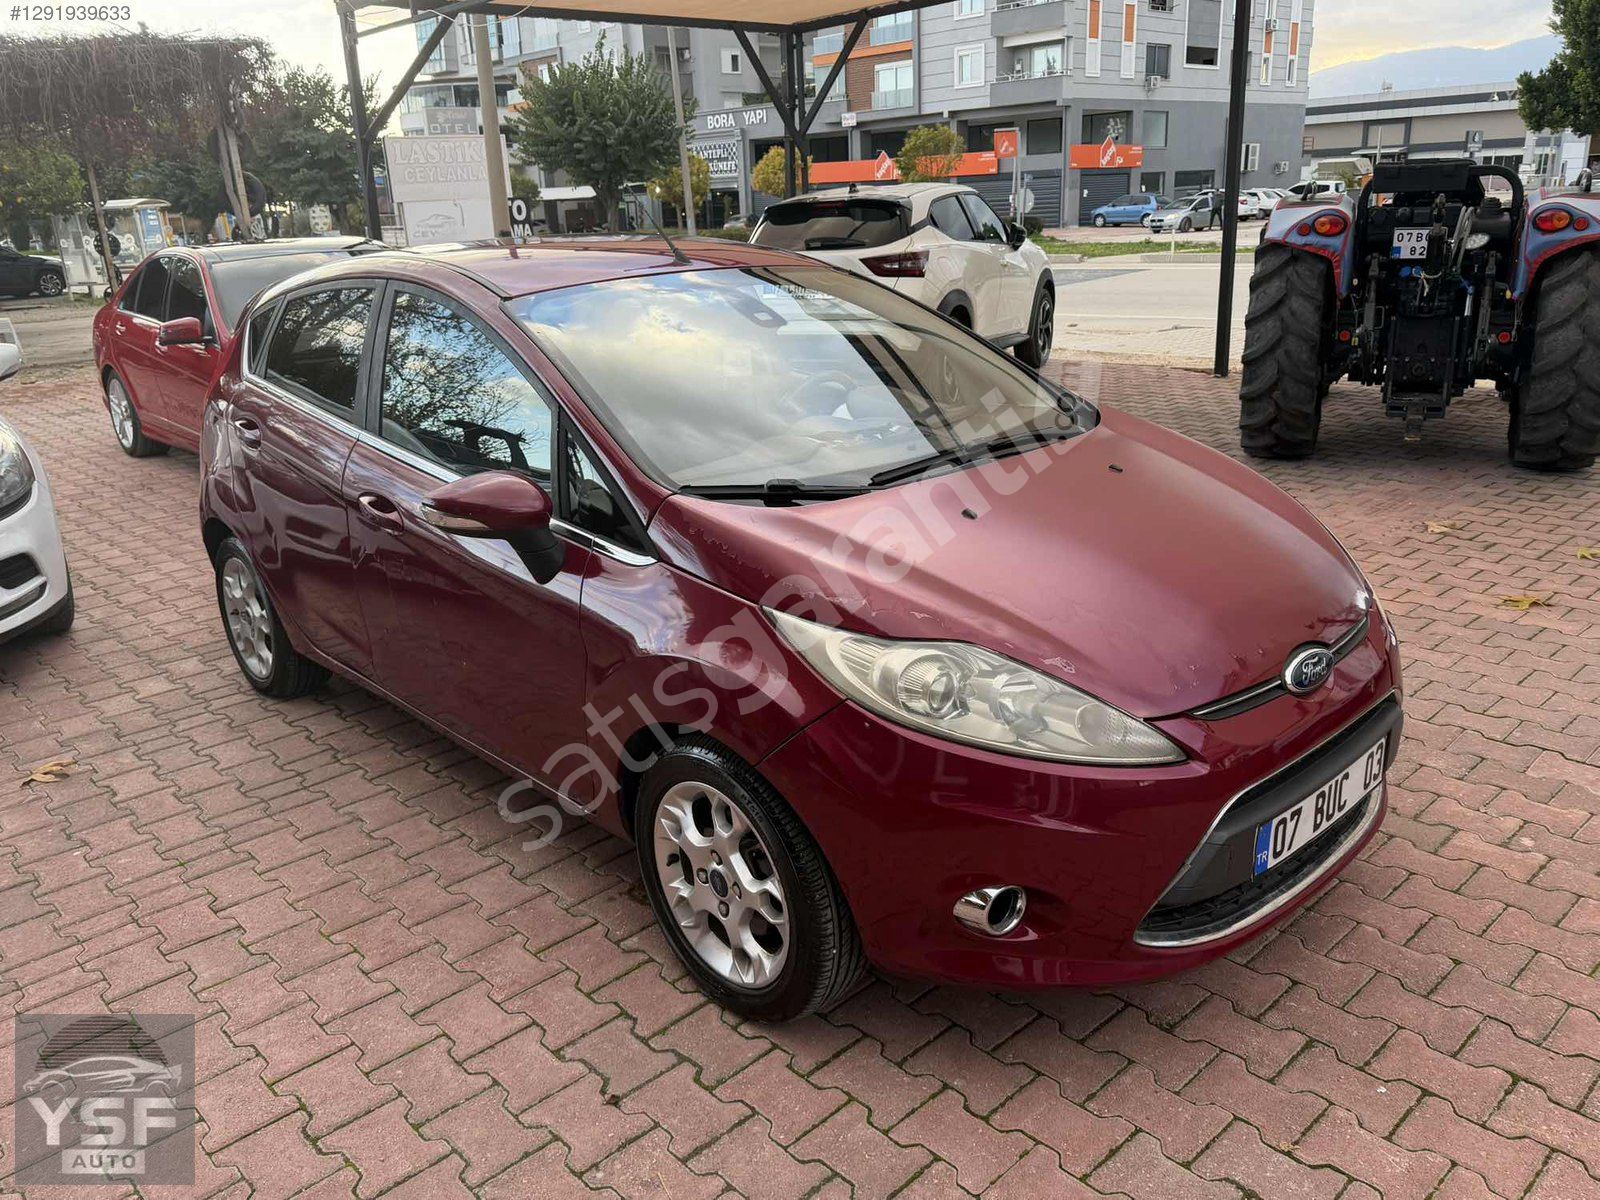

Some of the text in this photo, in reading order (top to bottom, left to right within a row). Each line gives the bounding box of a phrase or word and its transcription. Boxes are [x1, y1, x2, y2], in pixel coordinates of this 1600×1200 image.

[706, 108, 767, 129] BORA YAPI
[507, 199, 527, 221] O
[1301, 655, 1328, 685] Ford
[1272, 742, 1385, 860] 07 BUC 03
[1256, 851, 1268, 866] TR
